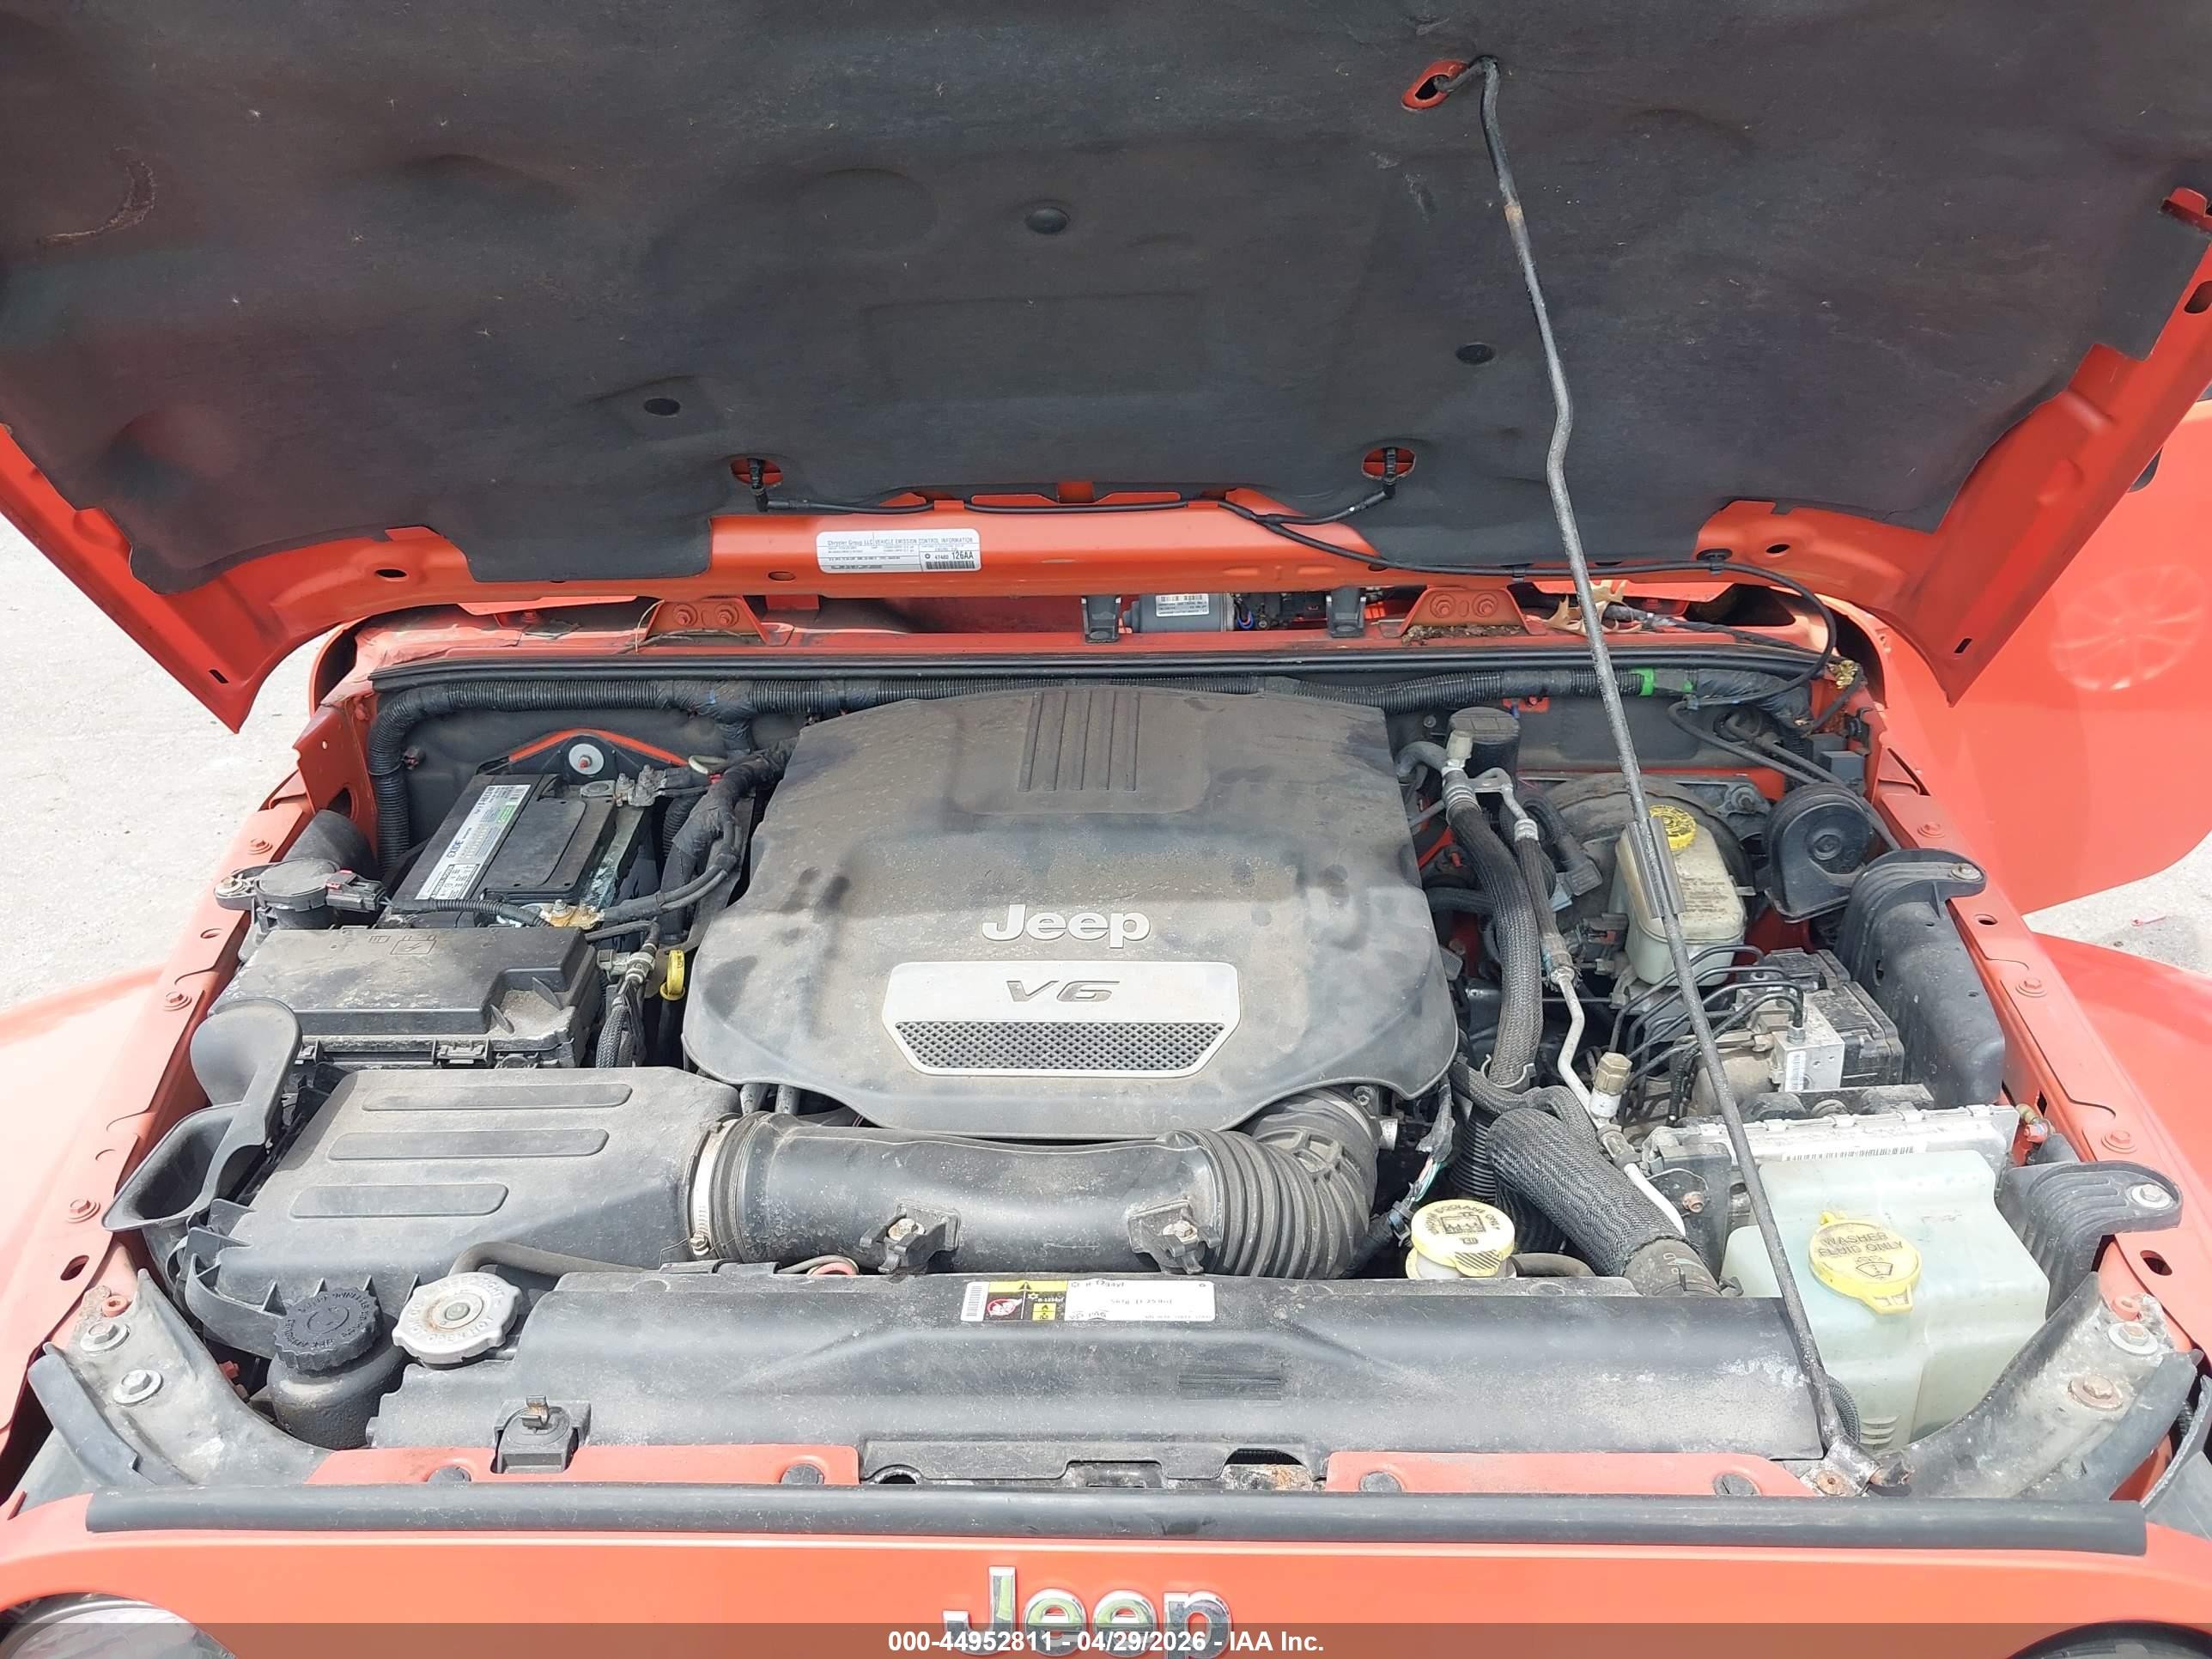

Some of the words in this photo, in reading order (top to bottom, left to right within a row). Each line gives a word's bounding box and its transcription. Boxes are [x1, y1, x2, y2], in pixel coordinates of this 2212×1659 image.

[951, 550, 974, 560] 126AA
[981, 904, 1151, 949] Jeep
[1006, 981, 1120, 1002] V6
[1821, 1231, 1888, 1246] WASHER
[1818, 1244, 1862, 1257] FLUID
[1866, 1240, 1904, 1253] ONLY
[942, 1566, 1234, 1659] Jeep
